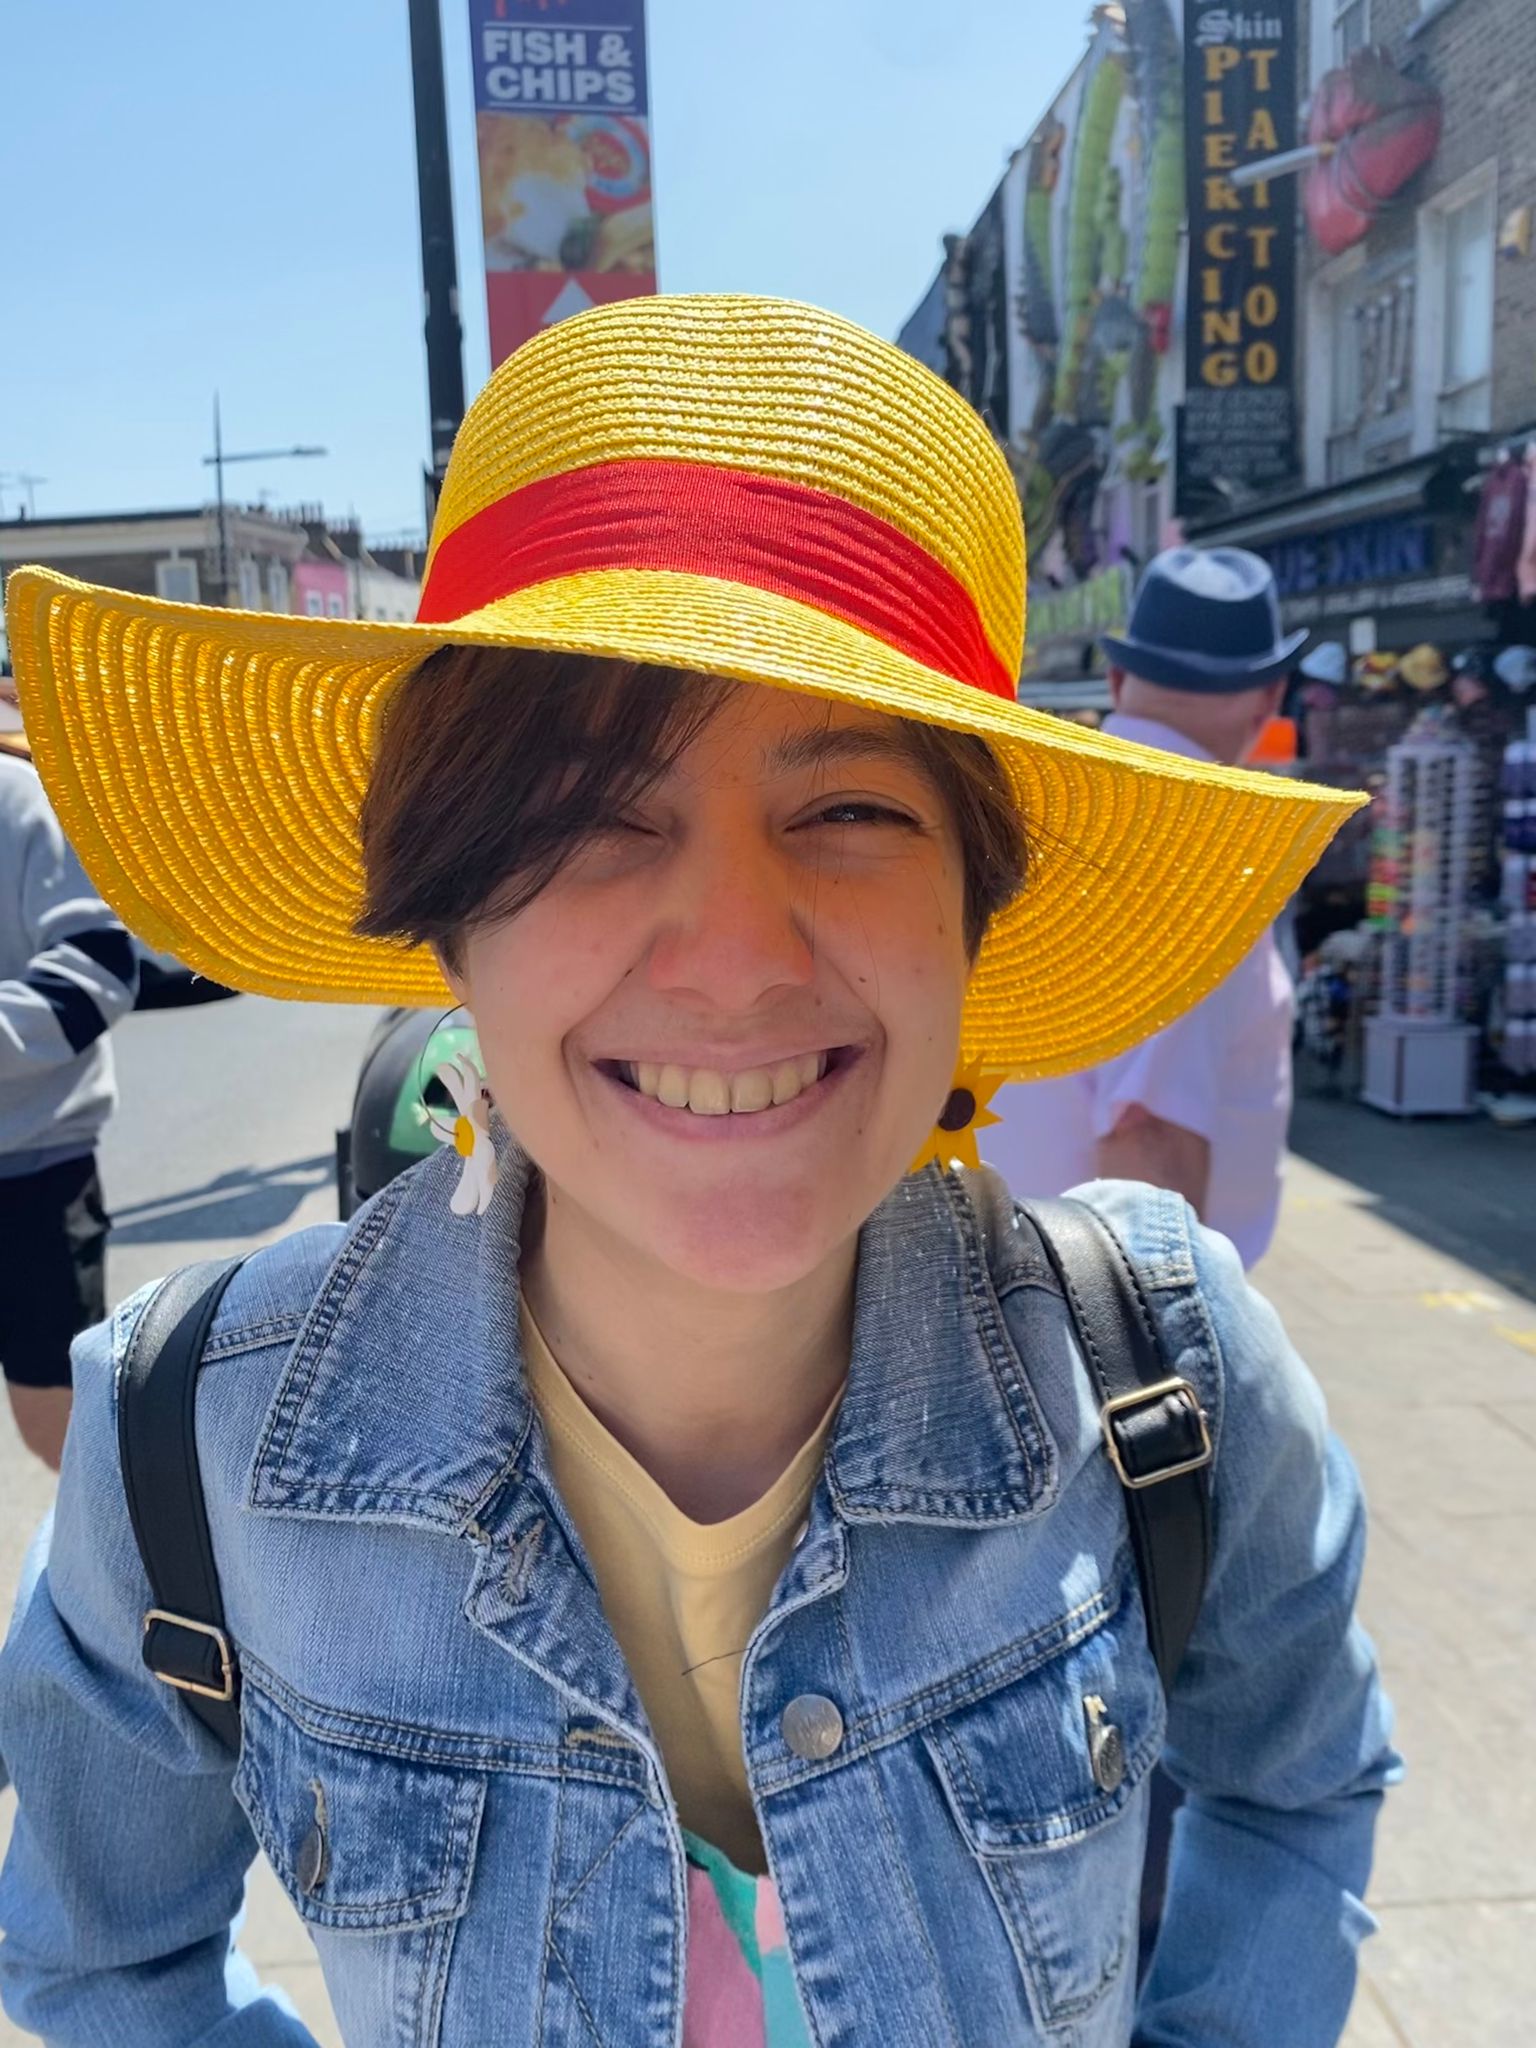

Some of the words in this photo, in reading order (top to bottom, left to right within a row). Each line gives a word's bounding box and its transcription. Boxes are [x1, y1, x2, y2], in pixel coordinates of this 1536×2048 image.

[482, 30, 587, 66] FISH
[597, 33, 633, 68] &
[485, 66, 637, 104] CHIPS
[1202, 46, 1242, 387] PIERCING
